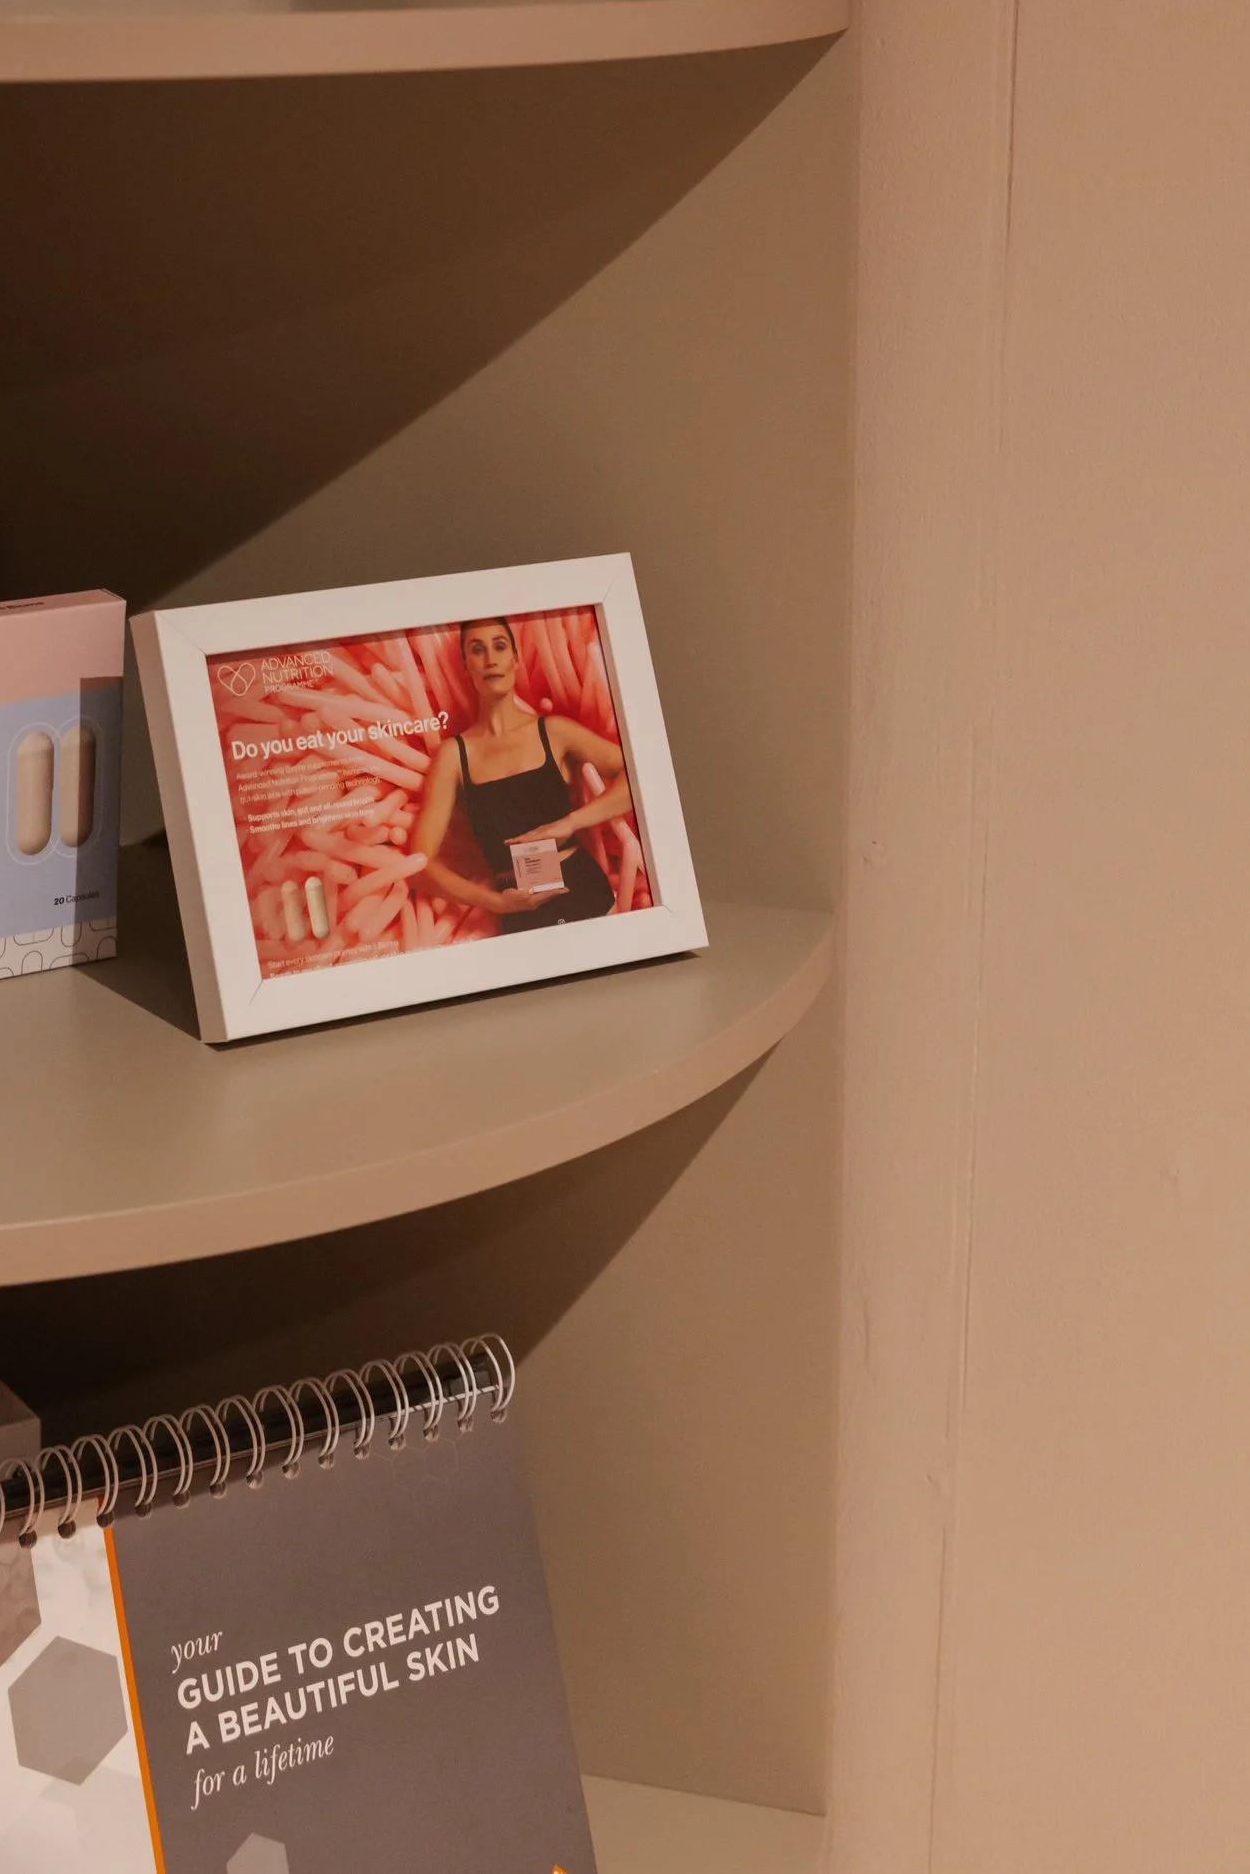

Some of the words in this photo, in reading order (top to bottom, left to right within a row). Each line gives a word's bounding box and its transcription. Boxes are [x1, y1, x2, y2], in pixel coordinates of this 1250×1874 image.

[261, 651, 331, 671] ADVANCED
[262, 665, 334, 684] NUTRITION
[231, 740, 258, 760] Do
[260, 739, 294, 760] you
[296, 731, 324, 751] eat
[325, 728, 364, 750] your
[367, 711, 449, 740] skincare?
[247, 810, 280, 823] Supports
[54, 897, 65, 906] 20
[170, 1631, 223, 1674] your
[177, 1651, 281, 1710] GUIDE
[287, 1637, 333, 1675] TO
[343, 1585, 500, 1658] CREATING
[186, 1720, 210, 1755] A
[217, 1662, 400, 1744] BEAUTIFUL
[406, 1633, 480, 1682] SKIN
[191, 1768, 225, 1810] for
[232, 1763, 247, 1786] a
[254, 1734, 335, 1785] lifetime
